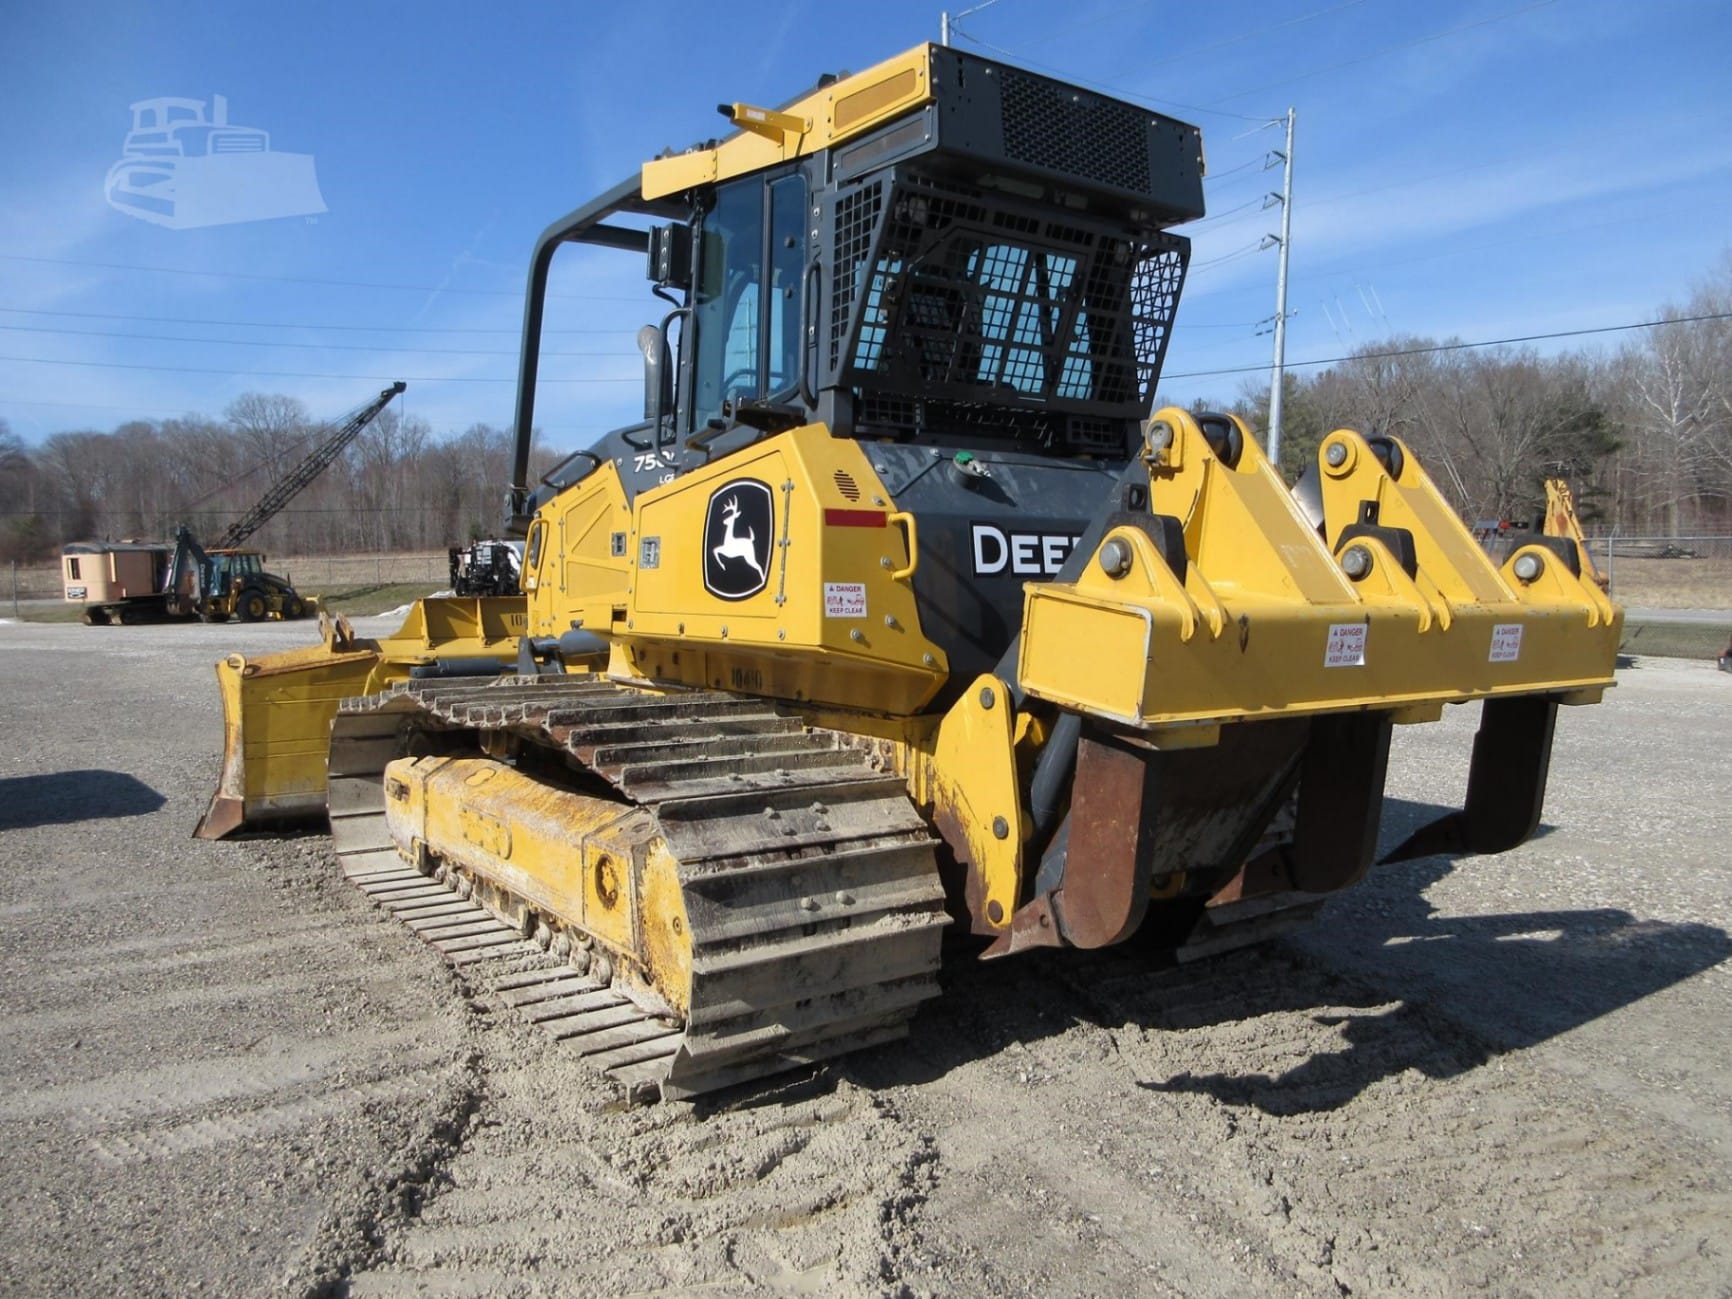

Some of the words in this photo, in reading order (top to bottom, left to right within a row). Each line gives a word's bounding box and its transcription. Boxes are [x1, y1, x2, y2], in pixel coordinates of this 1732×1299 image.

[1340, 628, 1363, 637] DANGER
[1329, 655, 1342, 663] KEEP
[1343, 655, 1360, 663] CLEAR
